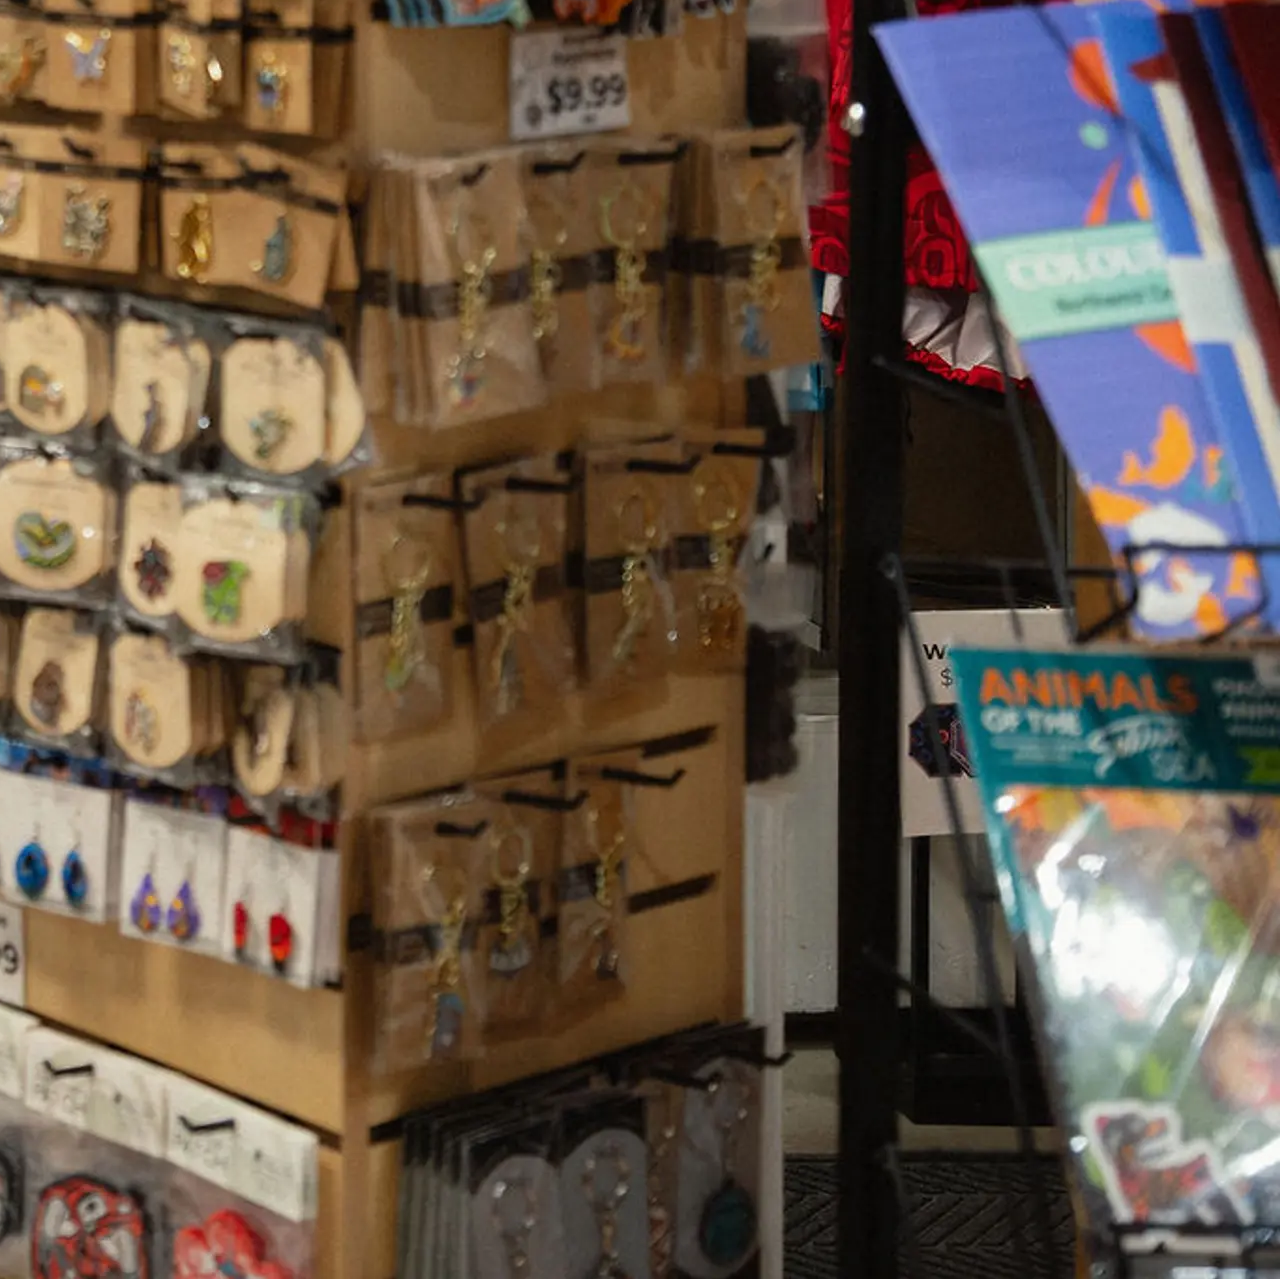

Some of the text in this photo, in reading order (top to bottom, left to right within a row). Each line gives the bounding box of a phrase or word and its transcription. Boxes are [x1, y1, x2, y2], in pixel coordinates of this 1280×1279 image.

[548, 73, 626, 116] $9.99
[980, 667, 1199, 715] ANIMALS
[1027, 708, 1082, 736] THE
